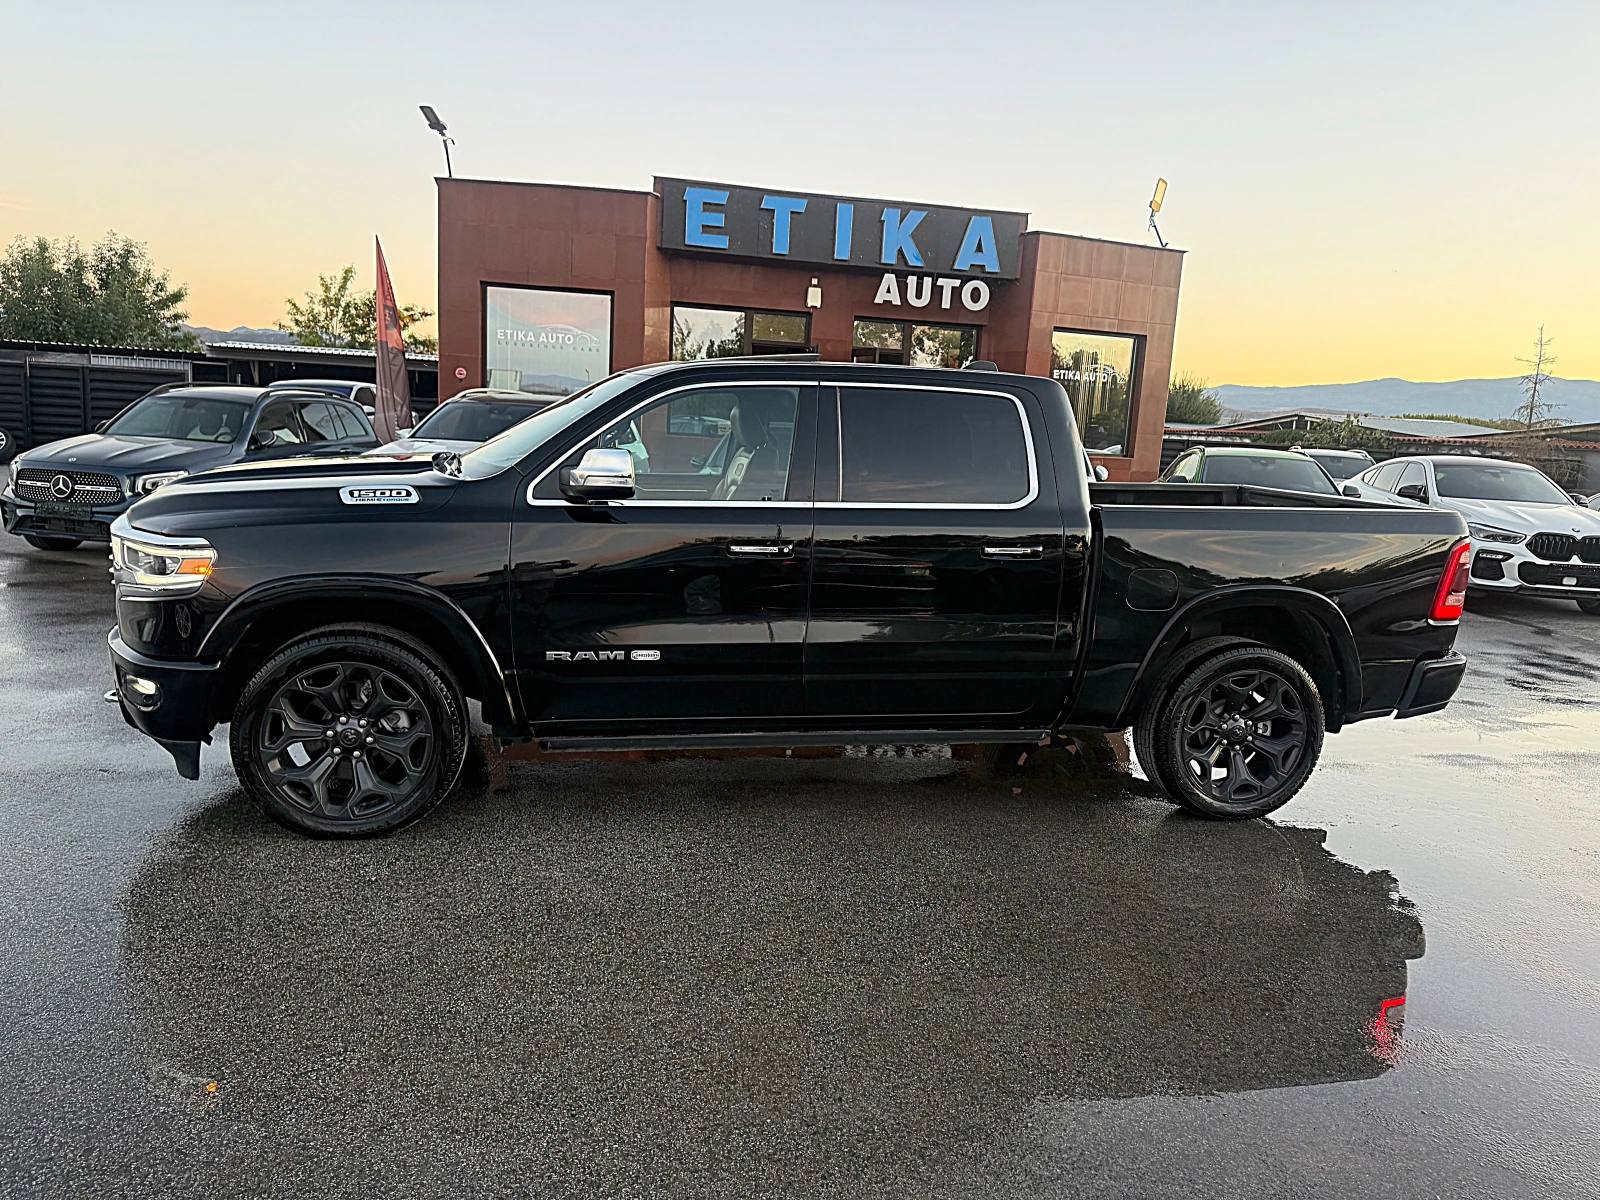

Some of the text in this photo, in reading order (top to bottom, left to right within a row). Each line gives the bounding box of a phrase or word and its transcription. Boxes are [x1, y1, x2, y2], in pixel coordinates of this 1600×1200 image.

[683, 186, 1000, 273] ETIKA
[874, 273, 990, 311] AUTO
[497, 329, 574, 344] ETIKA AUTO
[1053, 369, 1108, 382] ETIKA AUTO
[352, 490, 407, 498] 1500
[545, 650, 625, 661] RAM
